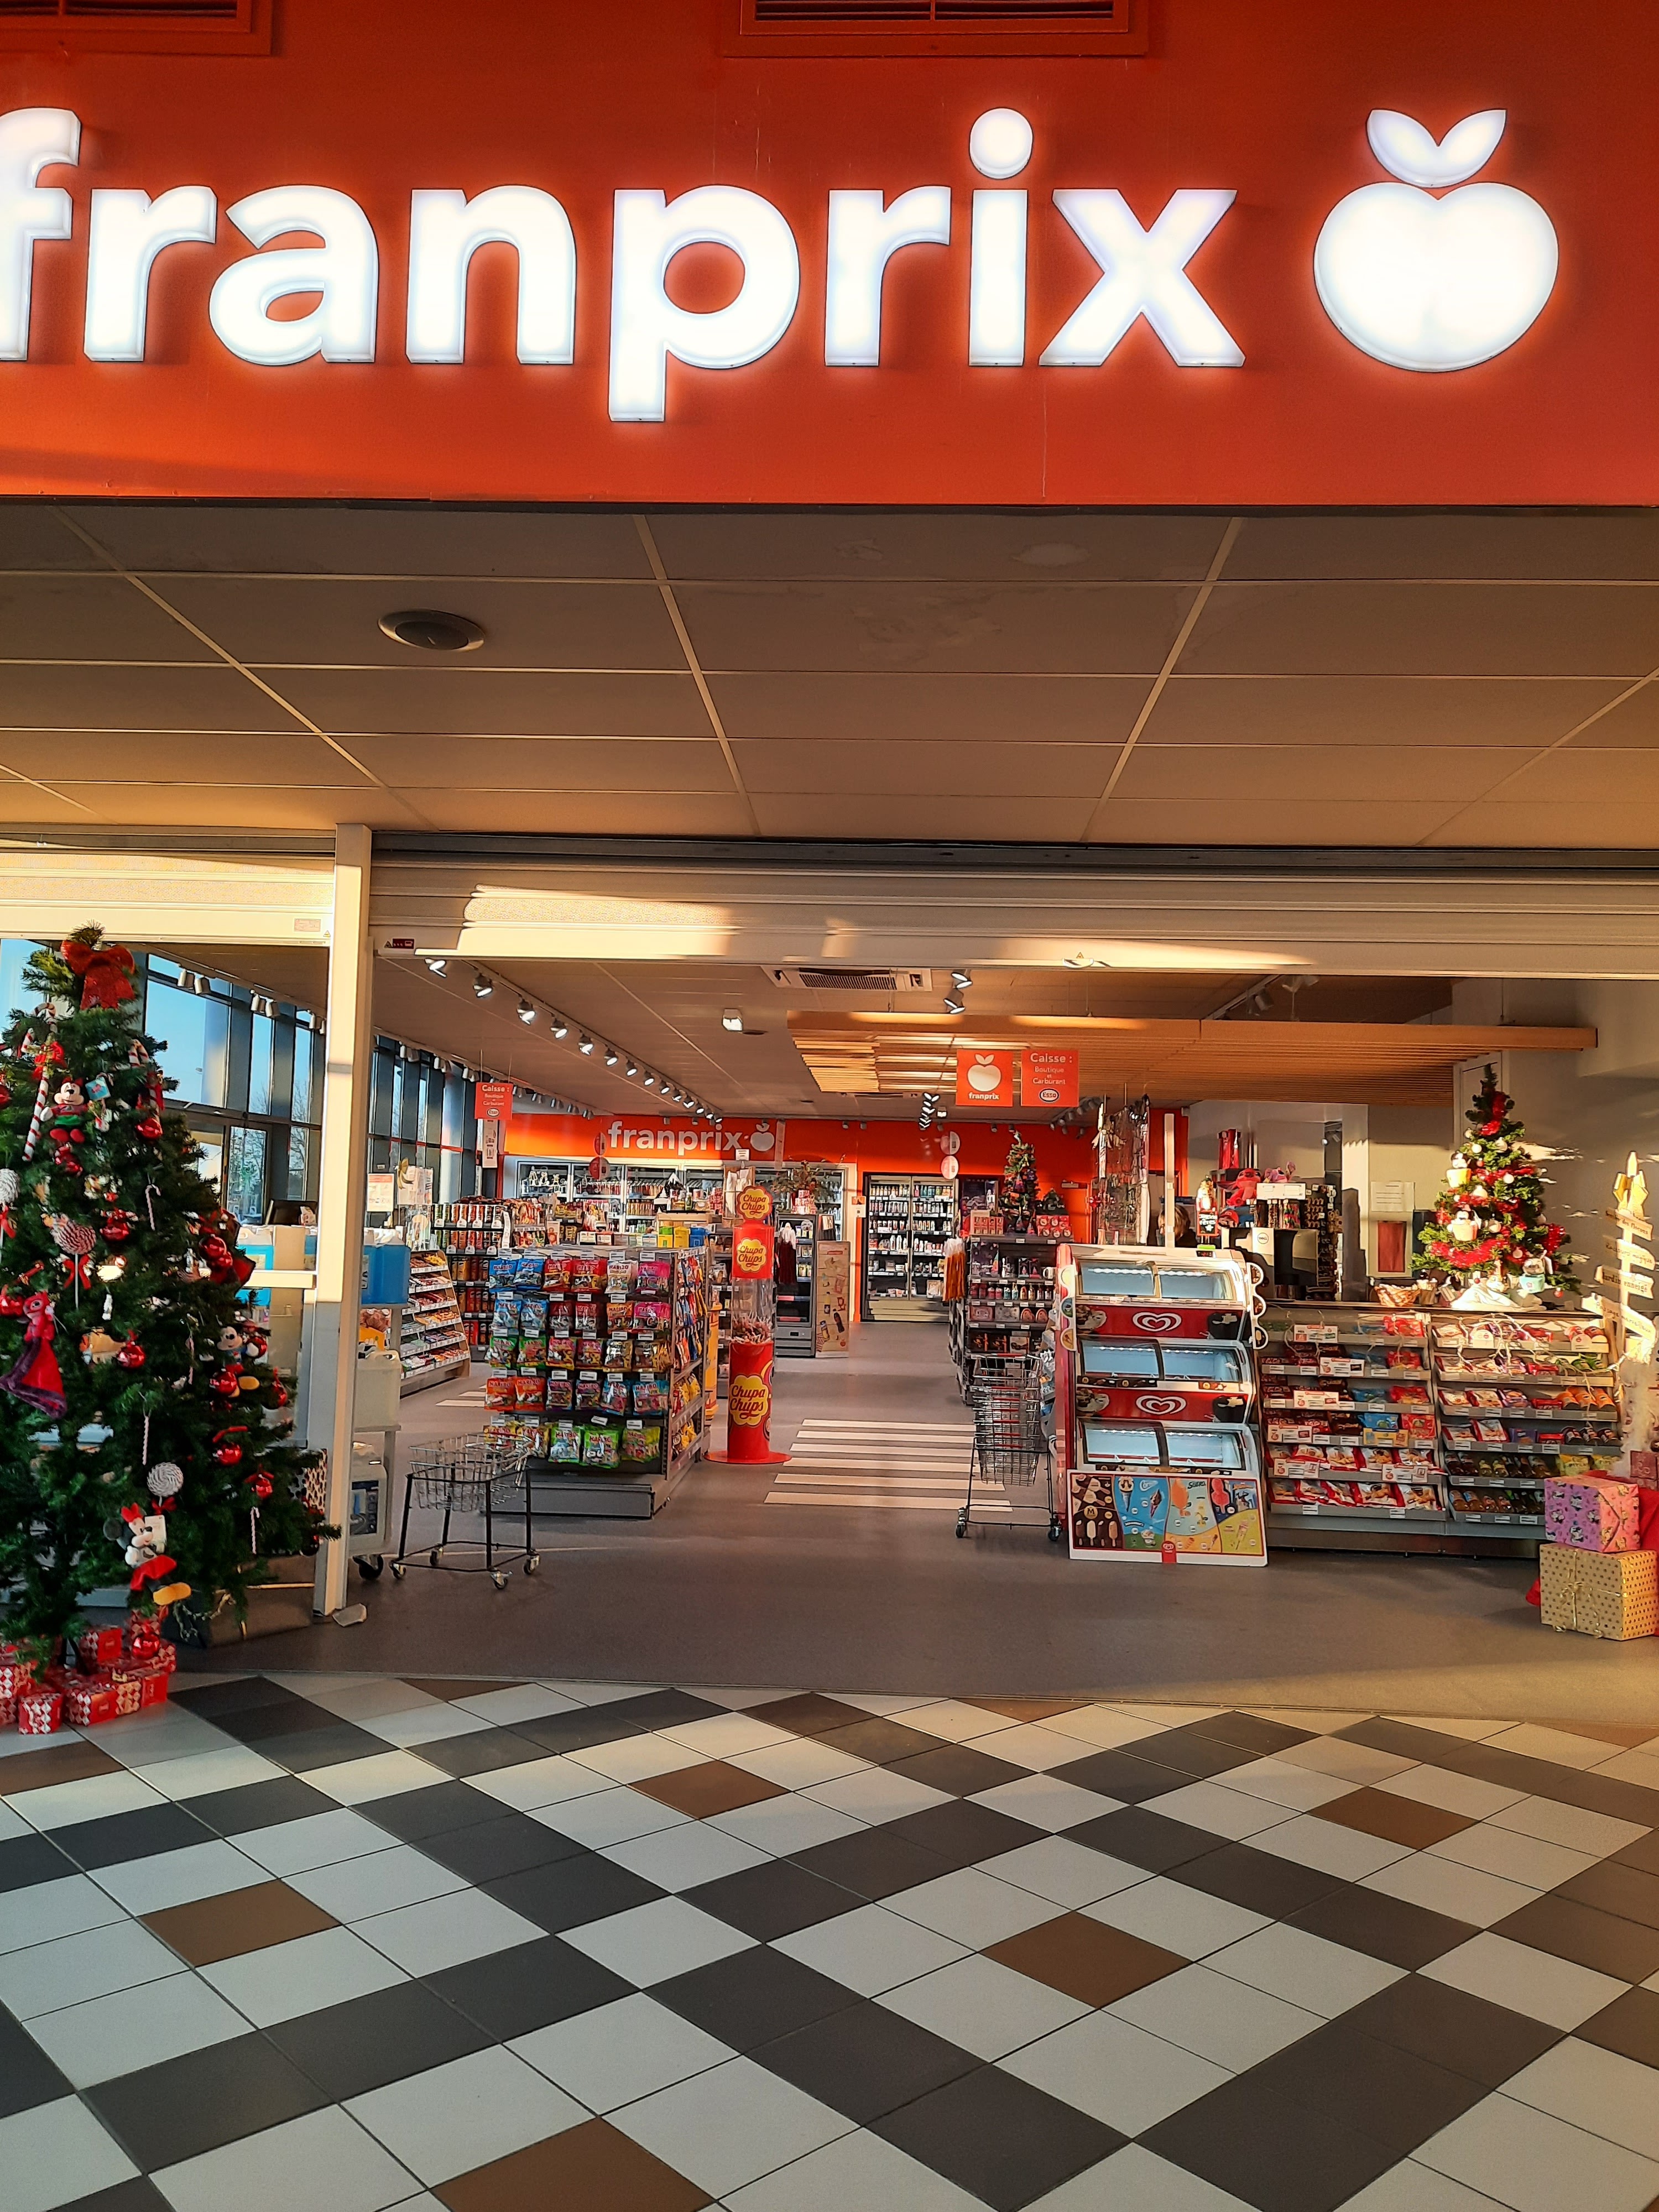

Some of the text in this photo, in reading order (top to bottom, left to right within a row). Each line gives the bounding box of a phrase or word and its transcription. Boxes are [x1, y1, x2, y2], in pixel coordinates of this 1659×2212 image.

[0, 106, 1245, 423] franprix
[1030, 1052, 1066, 1063] Caisse
[968, 1092, 1000, 1100] franprix
[608, 1121, 744, 1156] franprix
[743, 1194, 767, 1205] Chupa
[742, 1202, 765, 1214] Chups
[739, 1245, 764, 1256] Chupa
[738, 1253, 763, 1267] Chups
[731, 1385, 766, 1401] Chupa
[729, 1397, 764, 1420] Chups
